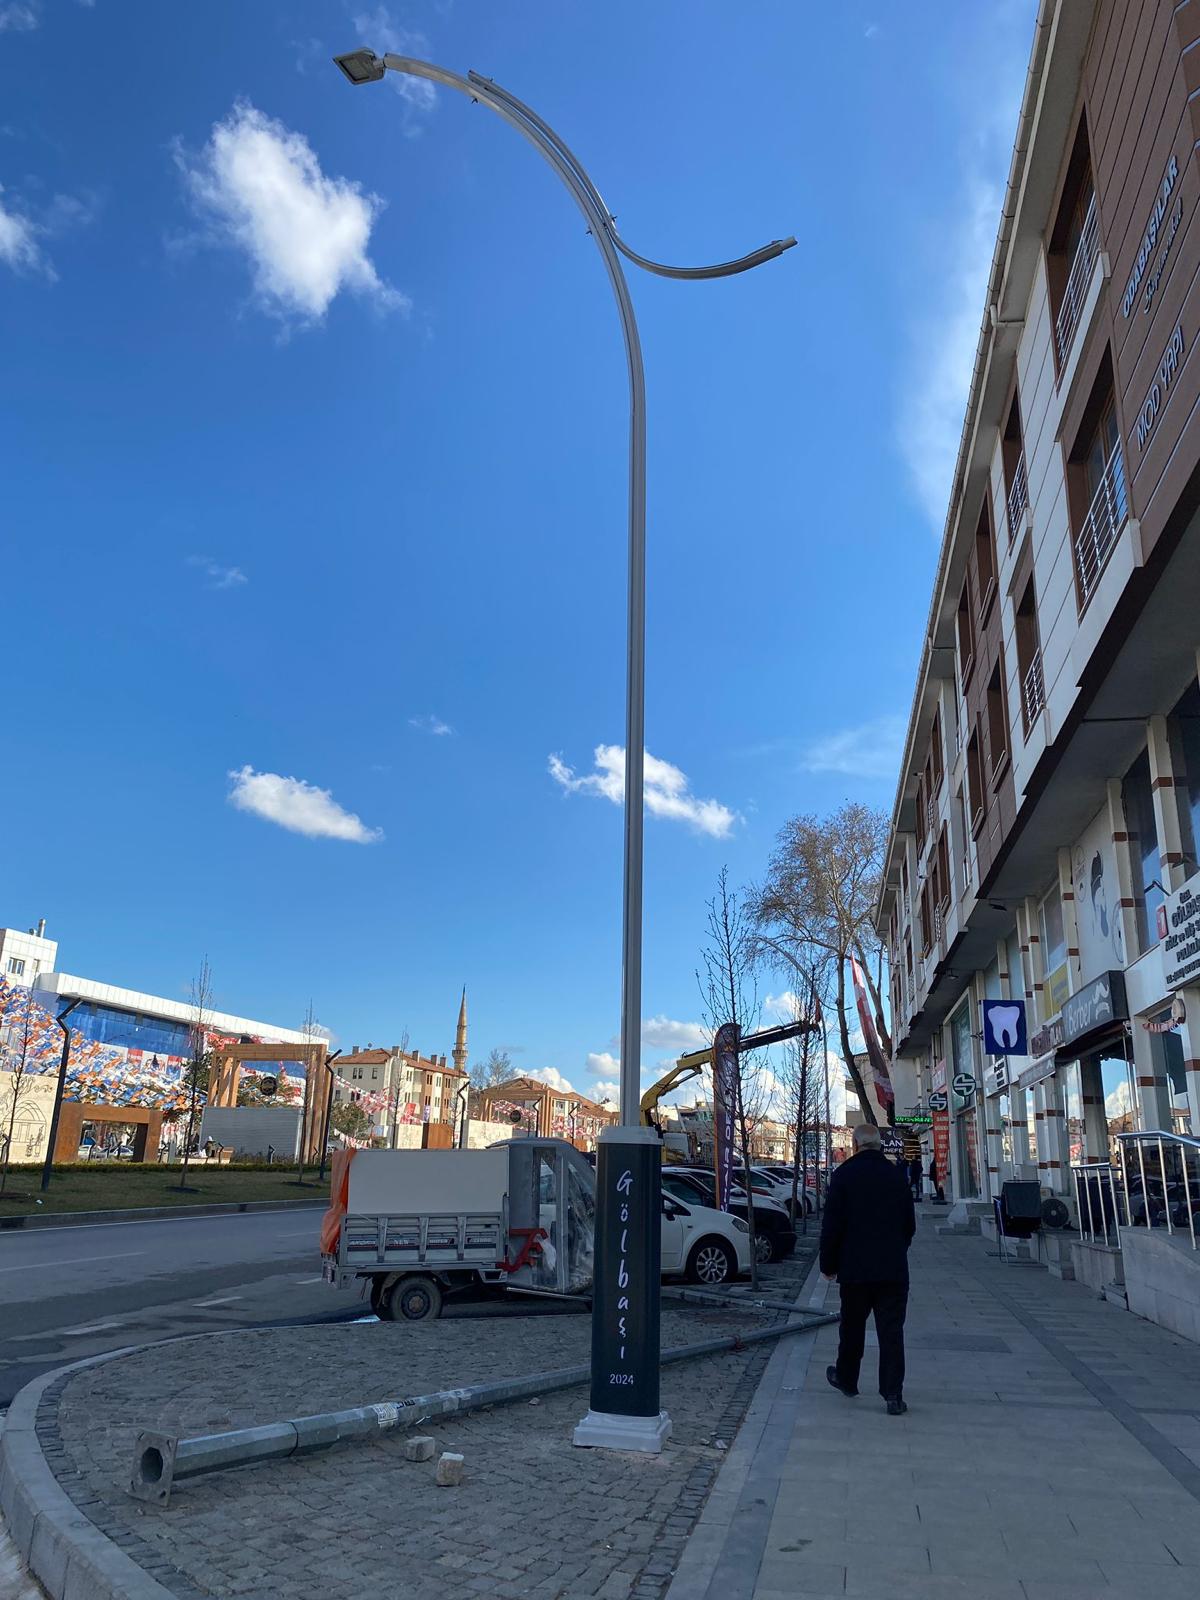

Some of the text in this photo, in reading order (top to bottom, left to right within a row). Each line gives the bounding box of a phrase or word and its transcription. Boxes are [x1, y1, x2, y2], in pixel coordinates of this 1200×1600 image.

[1122, 155, 1178, 319] ODABAŞILAR
[1136, 325, 1185, 452] MOD YAPI
[616, 1169, 634, 1360] Gölbaşı
[609, 1373, 634, 1386] 2024
